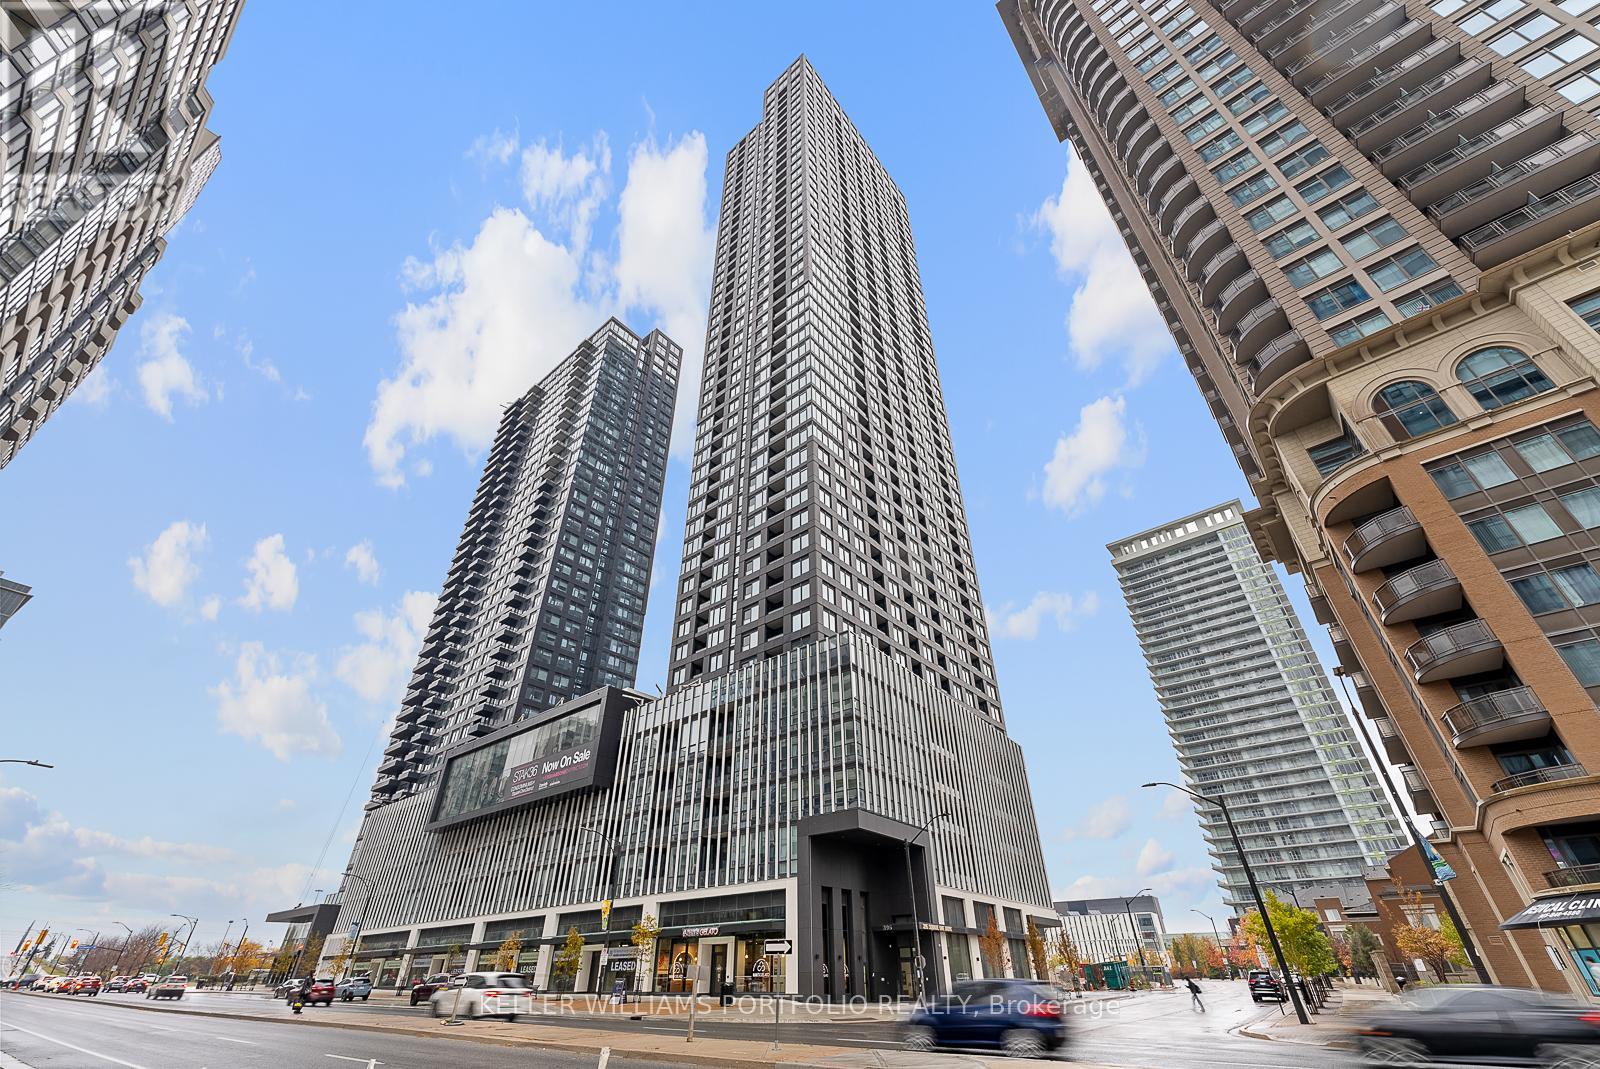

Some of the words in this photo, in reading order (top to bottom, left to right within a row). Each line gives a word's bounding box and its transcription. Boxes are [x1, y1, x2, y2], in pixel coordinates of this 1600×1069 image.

[541, 760, 560, 775] Now
[560, 755, 572, 768] On
[573, 749, 591, 764] Sale
[512, 765, 539, 783] STAK36
[610, 961, 636, 972] LEASED
